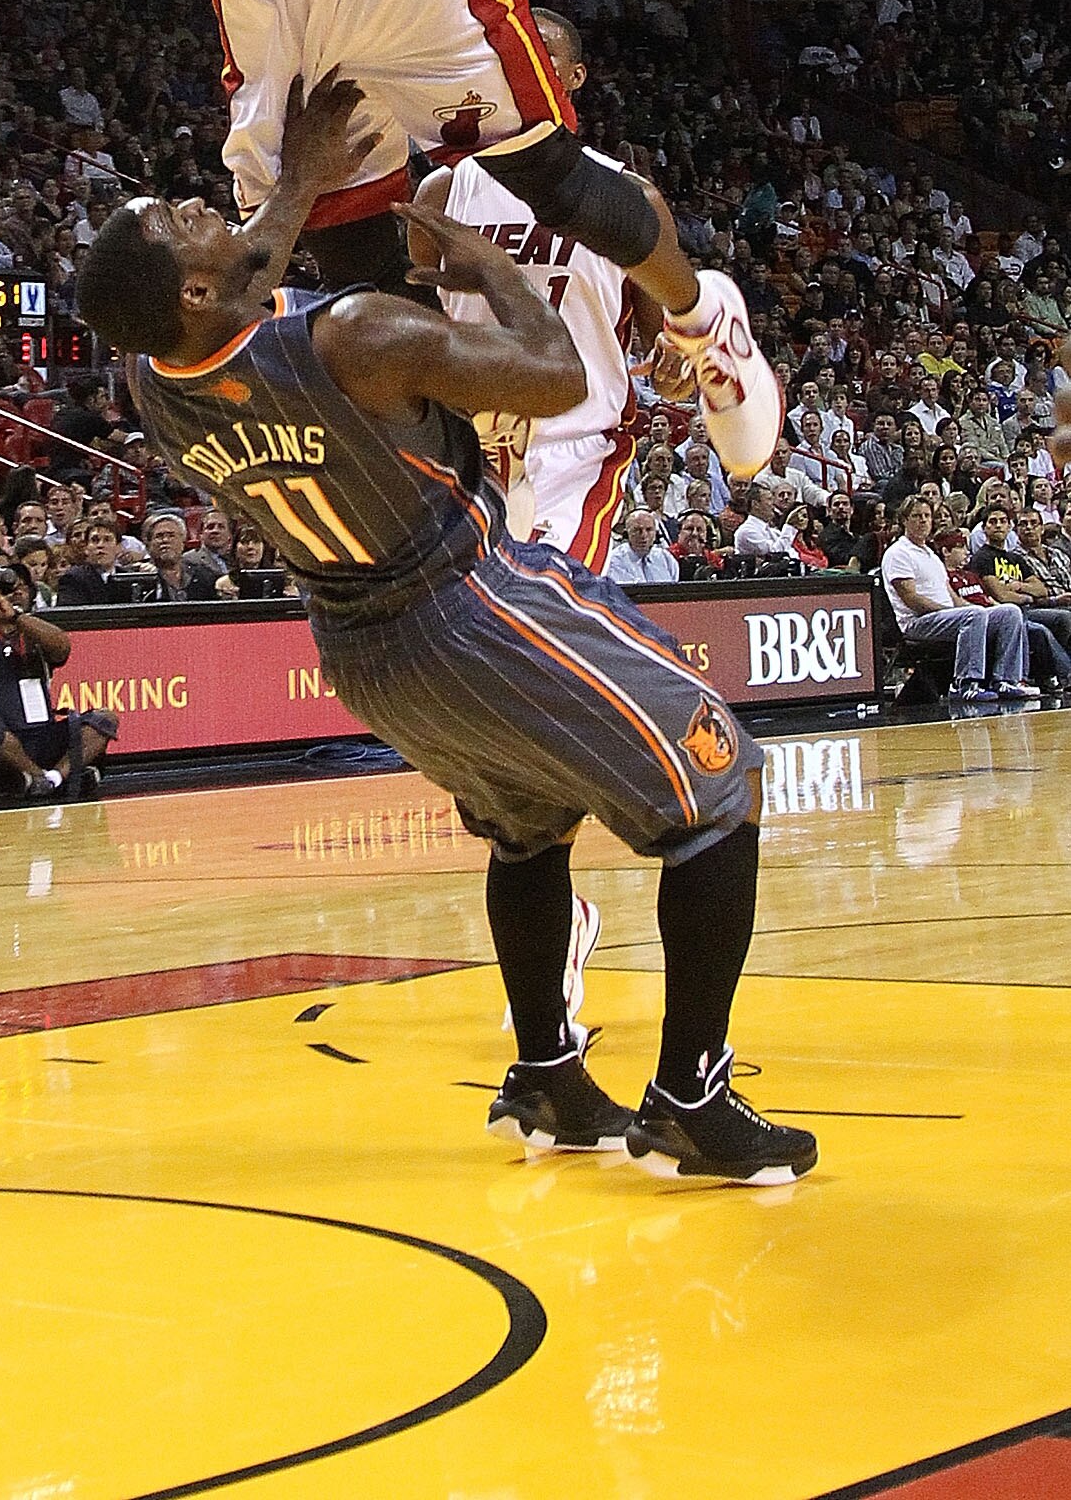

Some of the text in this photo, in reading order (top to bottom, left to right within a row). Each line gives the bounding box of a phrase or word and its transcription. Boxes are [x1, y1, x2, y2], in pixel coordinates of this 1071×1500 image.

[546, 273, 573, 315] 1
[181, 421, 326, 486] COLLINS
[243, 475, 375, 565] 11
[744, 608, 866, 687] BB&T
